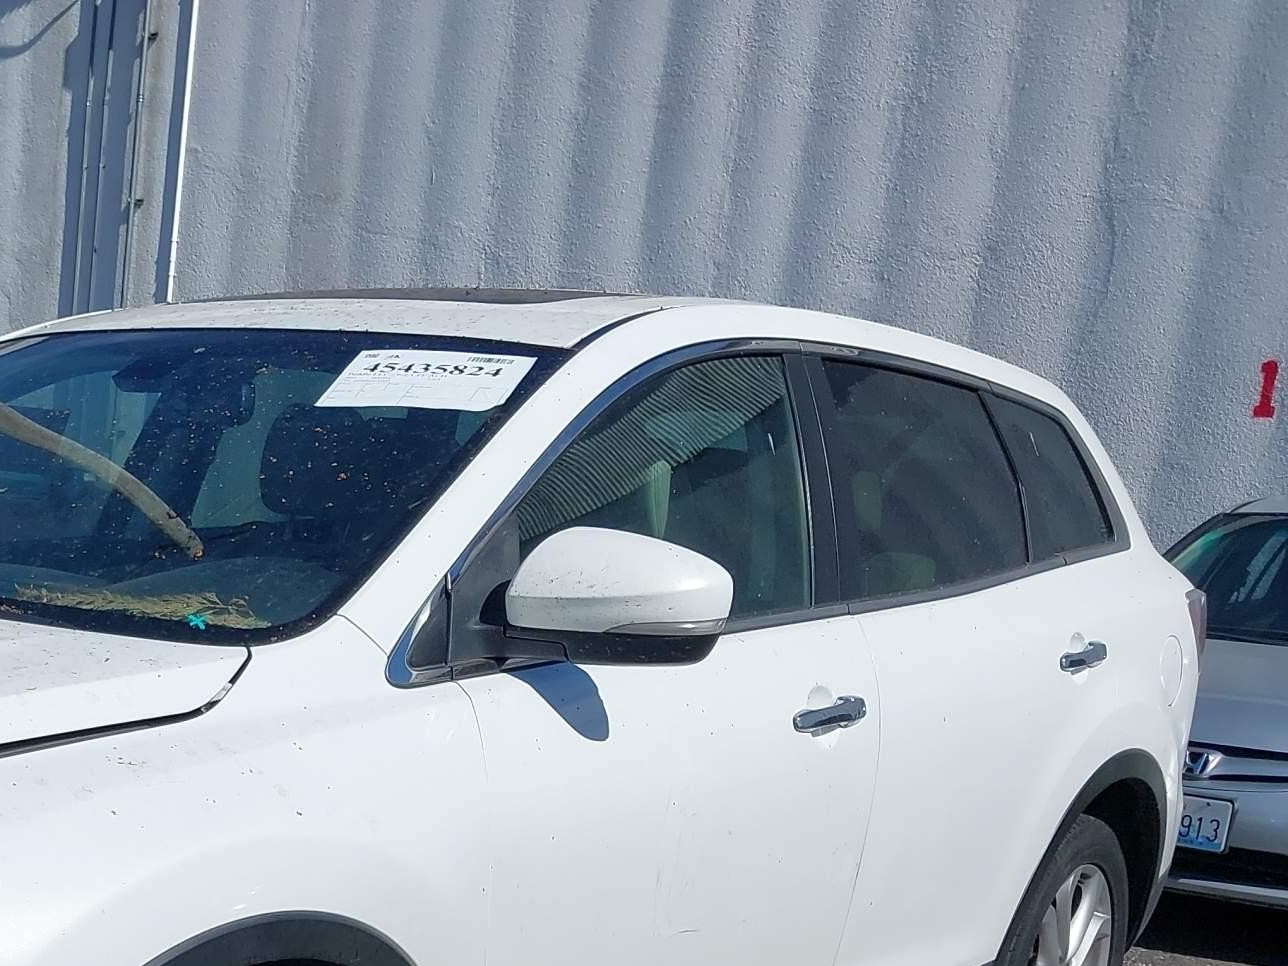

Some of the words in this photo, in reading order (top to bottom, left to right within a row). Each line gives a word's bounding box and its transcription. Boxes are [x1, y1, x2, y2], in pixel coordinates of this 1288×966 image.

[363, 362, 504, 377] 45435824
[1253, 360, 1279, 418] 1
[1179, 814, 1221, 842] 913
